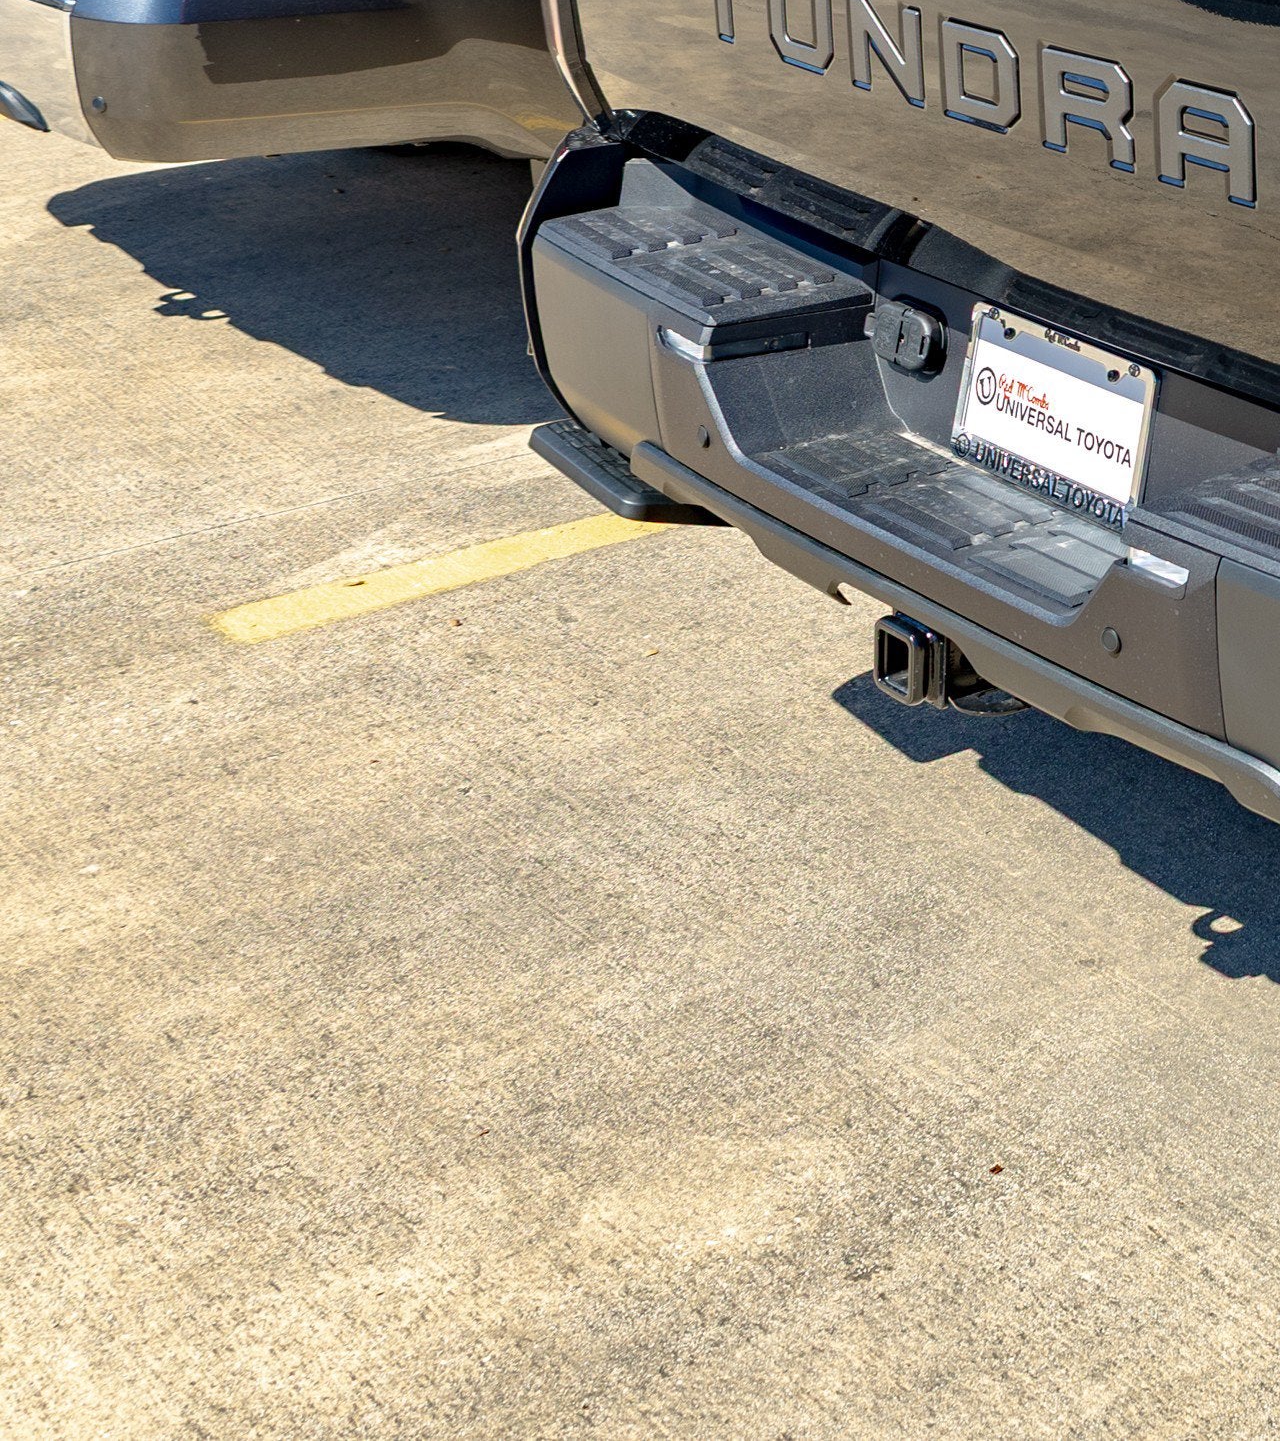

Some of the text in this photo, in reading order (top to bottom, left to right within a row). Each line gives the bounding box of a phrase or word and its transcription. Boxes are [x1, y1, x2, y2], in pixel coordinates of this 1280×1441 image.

[996, 393, 1132, 468] UNIVERSAL TOYOTA
[975, 442, 1126, 528] UNIVERSAL TOYOTA
